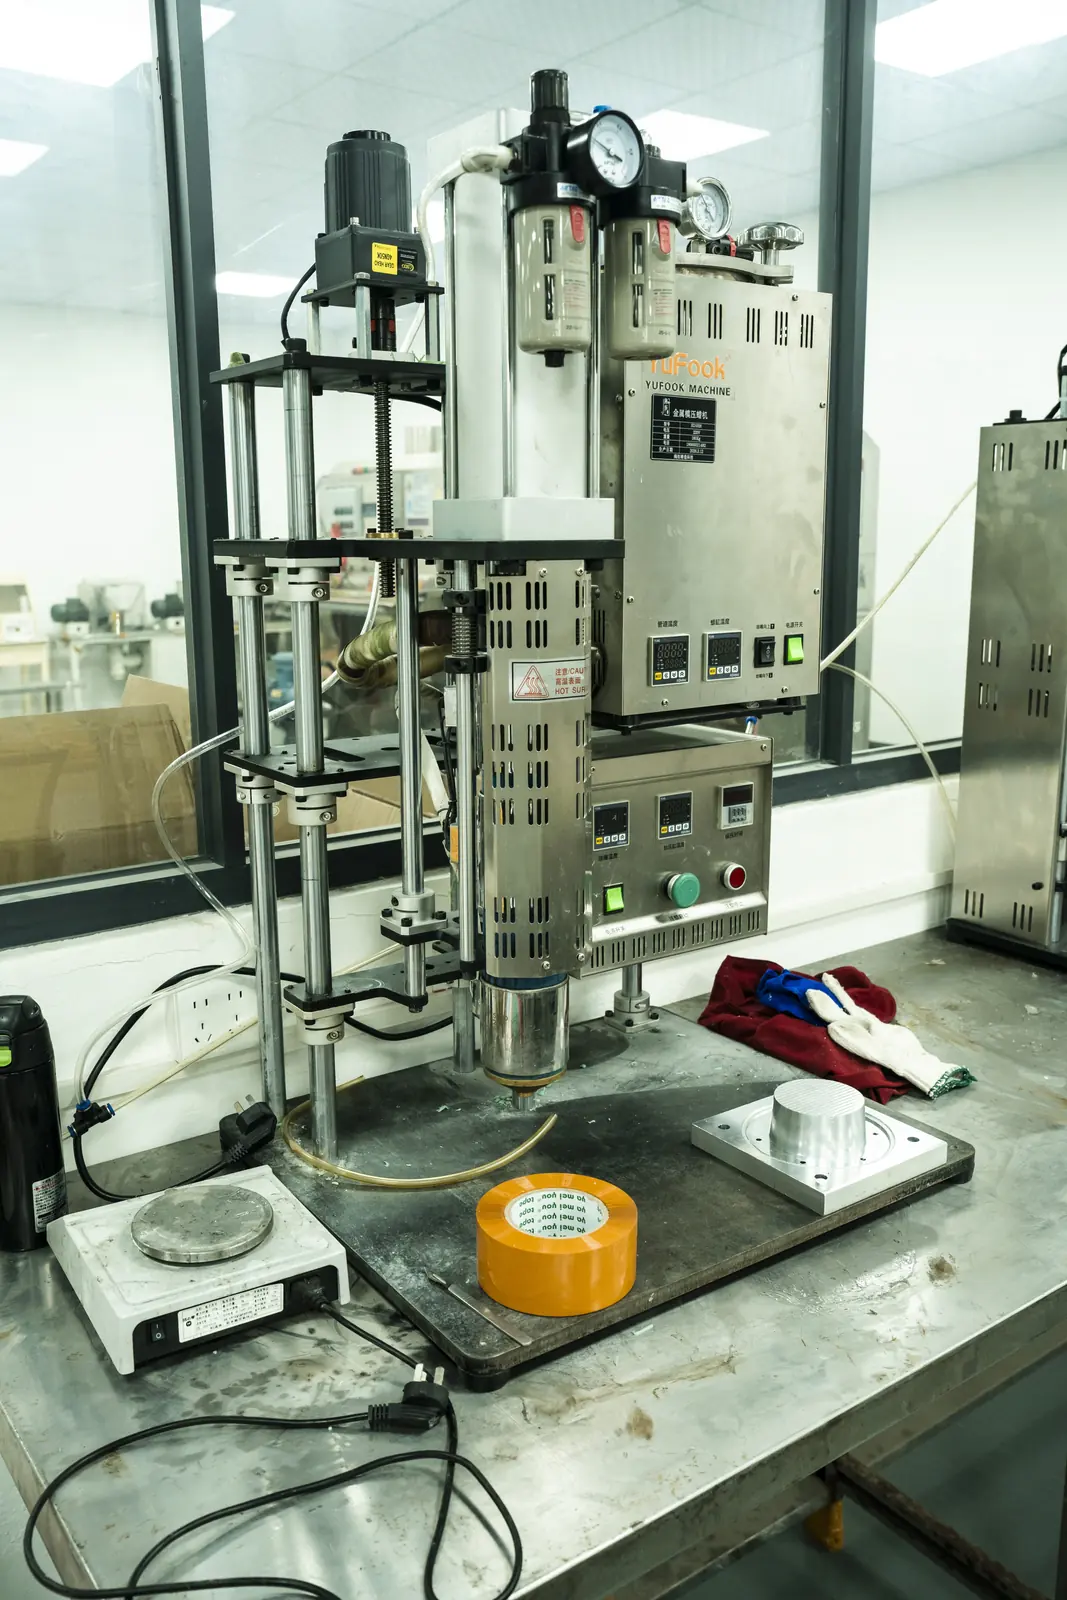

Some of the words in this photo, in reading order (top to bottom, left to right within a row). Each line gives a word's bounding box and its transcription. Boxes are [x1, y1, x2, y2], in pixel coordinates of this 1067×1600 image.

[646, 380, 685, 392] YUFOOK
[689, 384, 731, 396] MACHINE
[555, 666, 586, 676] 注意/CAU
[555, 676, 582, 685] 高温表面
